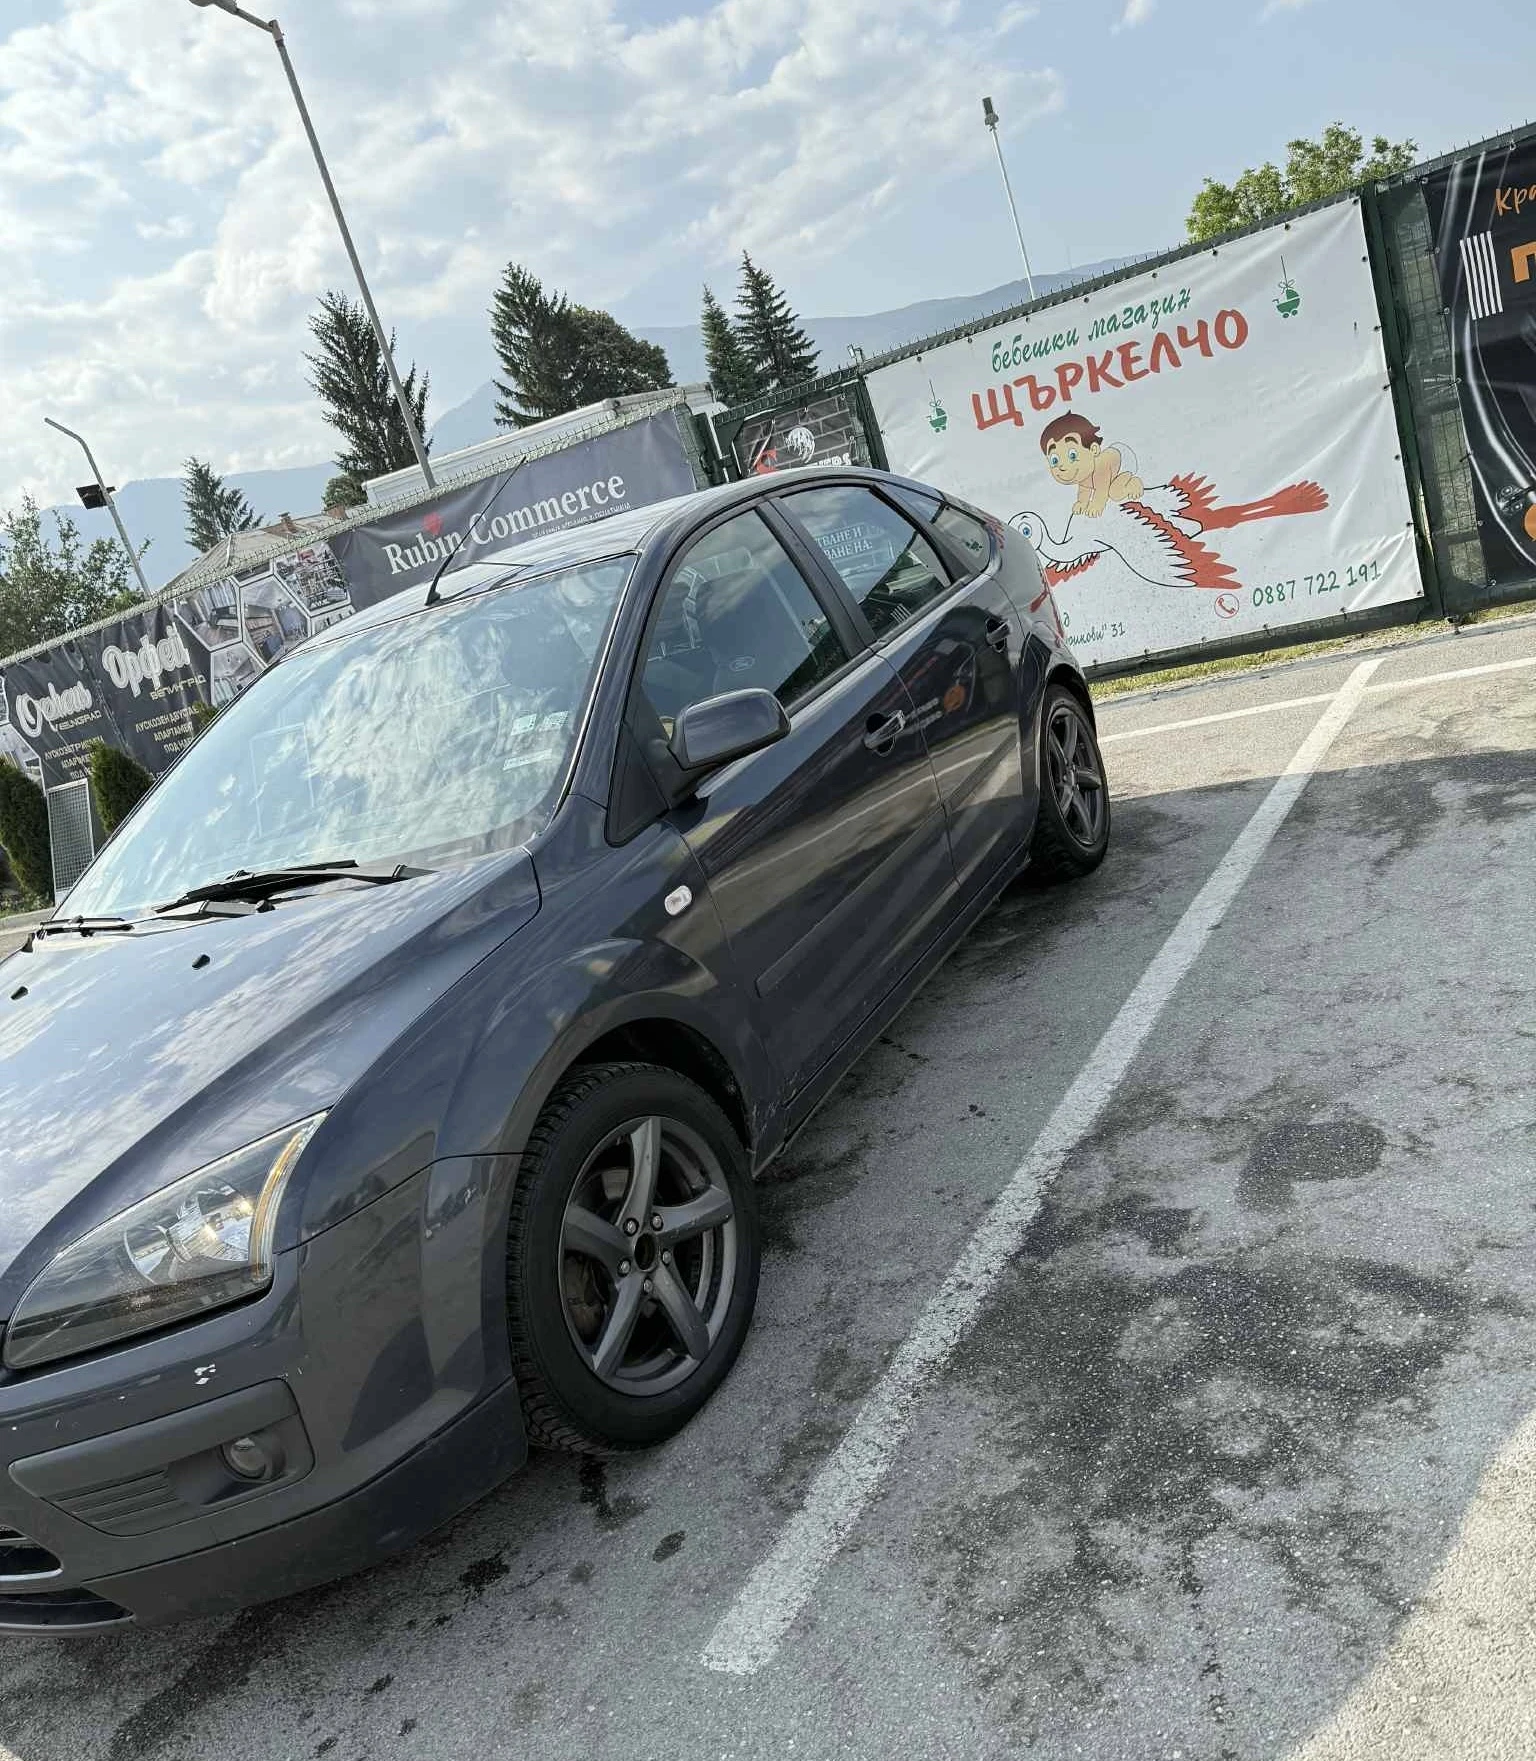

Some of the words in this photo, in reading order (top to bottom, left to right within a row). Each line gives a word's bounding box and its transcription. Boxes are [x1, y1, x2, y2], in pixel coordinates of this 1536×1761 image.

[971, 308, 1249, 431] ЩЪРКЕЛЧО
[992, 327, 1079, 373] бебешки
[1088, 286, 1191, 343] магазин
[383, 531, 466, 575] Rubin
[469, 475, 626, 546] Commerce
[1252, 580, 1296, 607] 0887
[1304, 570, 1340, 595] 722
[1345, 560, 1382, 587] 191
[1111, 622, 1126, 638] 31
